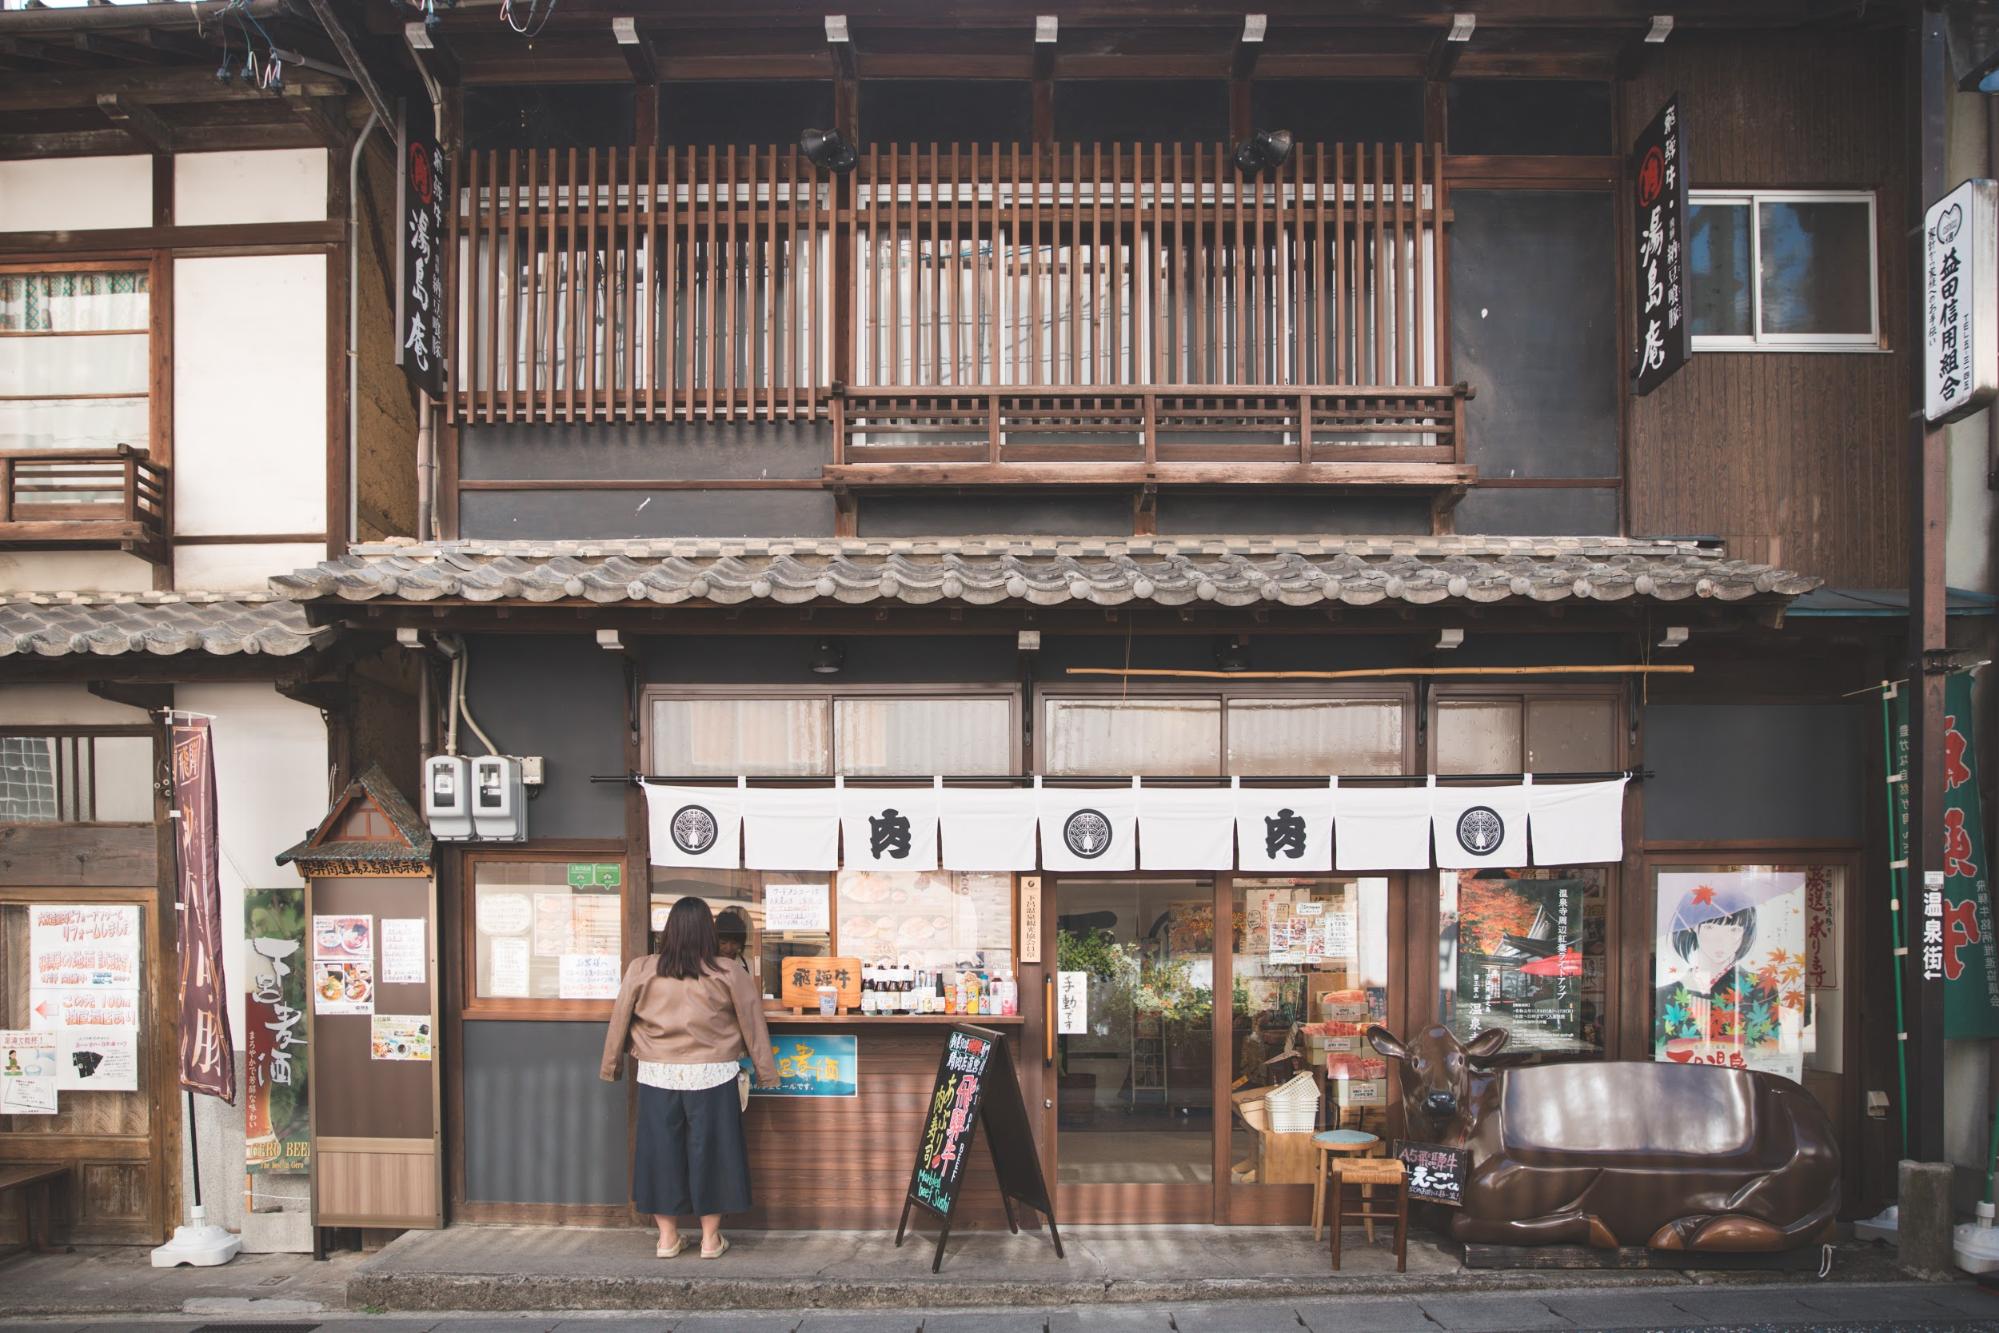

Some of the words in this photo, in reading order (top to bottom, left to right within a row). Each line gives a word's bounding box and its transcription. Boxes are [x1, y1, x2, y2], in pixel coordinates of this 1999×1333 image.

[405, 207, 430, 372] 湯島庵
[1639, 204, 1666, 379] 湯島庵
[1940, 246, 1961, 402] 益田信用組合
[868, 808, 913, 860] 肉
[1264, 808, 1307, 860] 肉
[1557, 888, 1569, 1001] 温泉寺周辺紅葉ライトアップ
[1923, 892, 1943, 970] 温泉街
[253, 938, 308, 1087] 下呂麦酒
[792, 967, 856, 993] 飛騨牛
[1061, 975, 1078, 1030] 手動です
